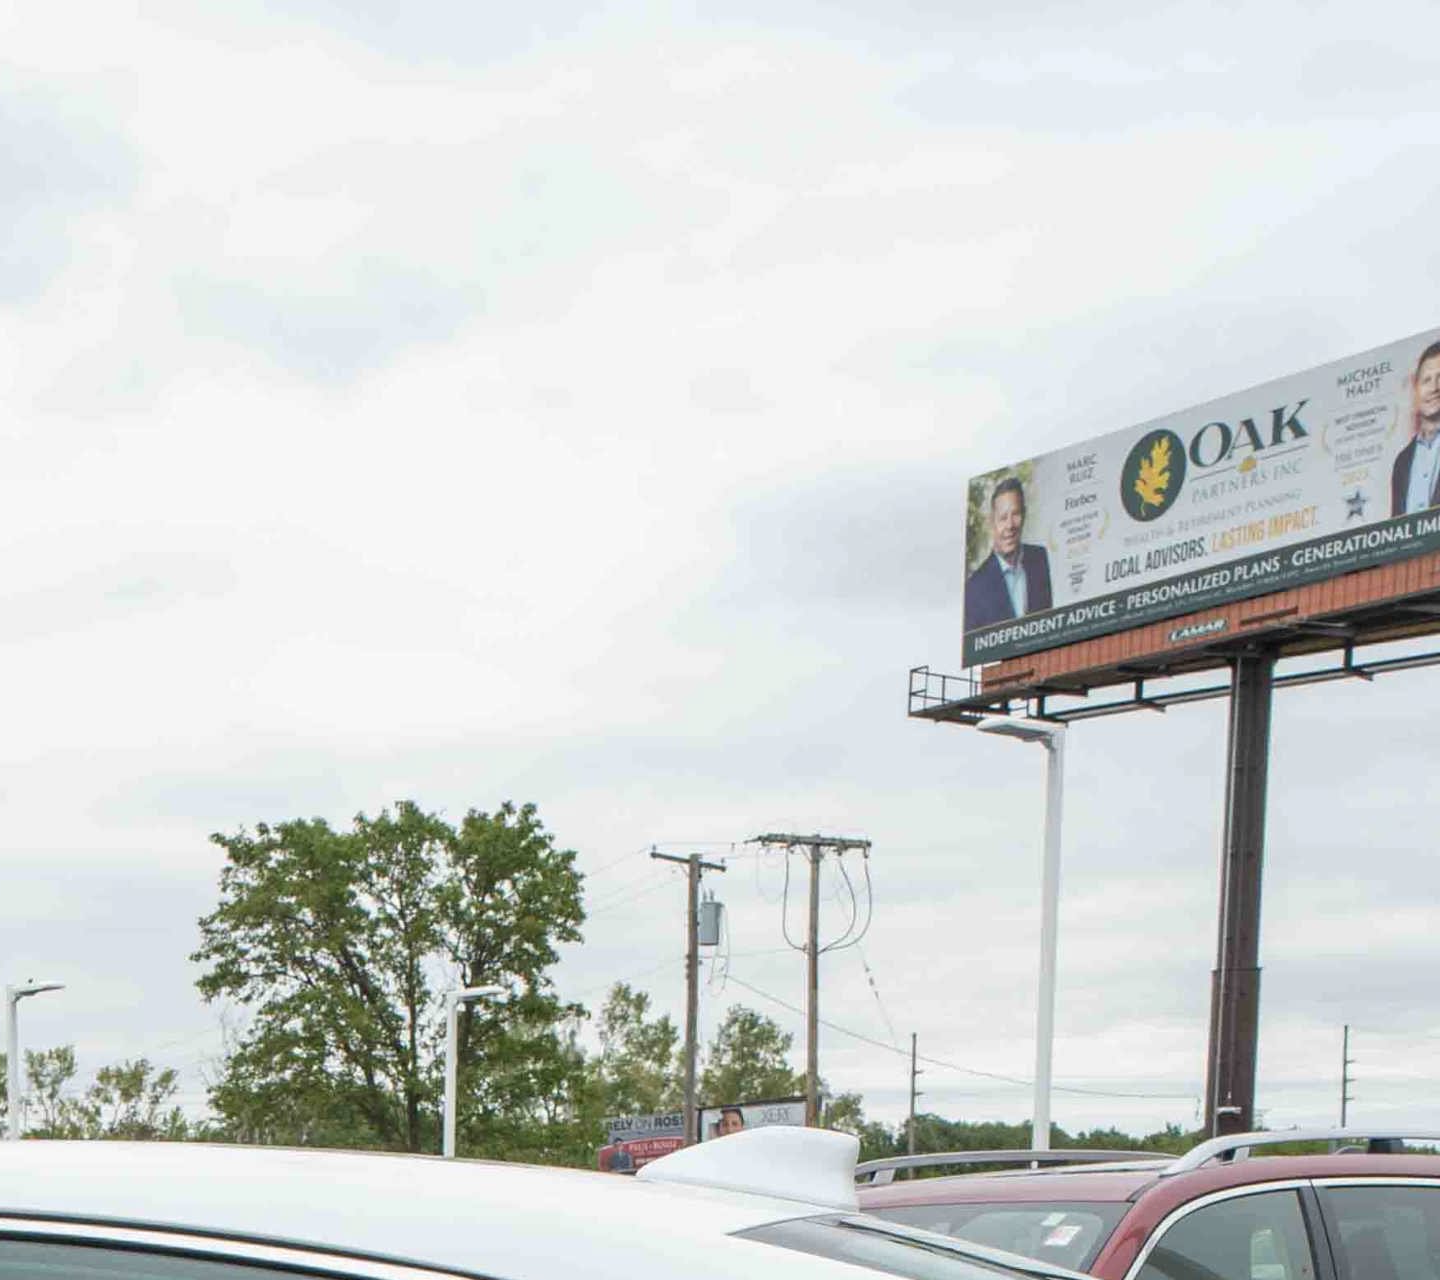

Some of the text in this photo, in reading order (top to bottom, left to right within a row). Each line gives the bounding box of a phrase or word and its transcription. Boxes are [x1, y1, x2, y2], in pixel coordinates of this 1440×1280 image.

[1337, 362, 1393, 387] MICHAEL
[1189, 399, 1311, 468] OAK
[1064, 493, 1097, 511] Forbes
[1192, 470, 1268, 504] PARTNERS
[1274, 458, 1304, 481] INC
[1105, 556, 1140, 583] LOCAL
[1211, 520, 1266, 552] LASTING
[974, 615, 1065, 652] INDEPENDENT
[1066, 599, 1117, 625] ADVICE
[1126, 570, 1232, 610] PERSONALIZED
[1233, 556, 1281, 582] PLANS
[1291, 523, 1414, 566] GENERATIONAL
